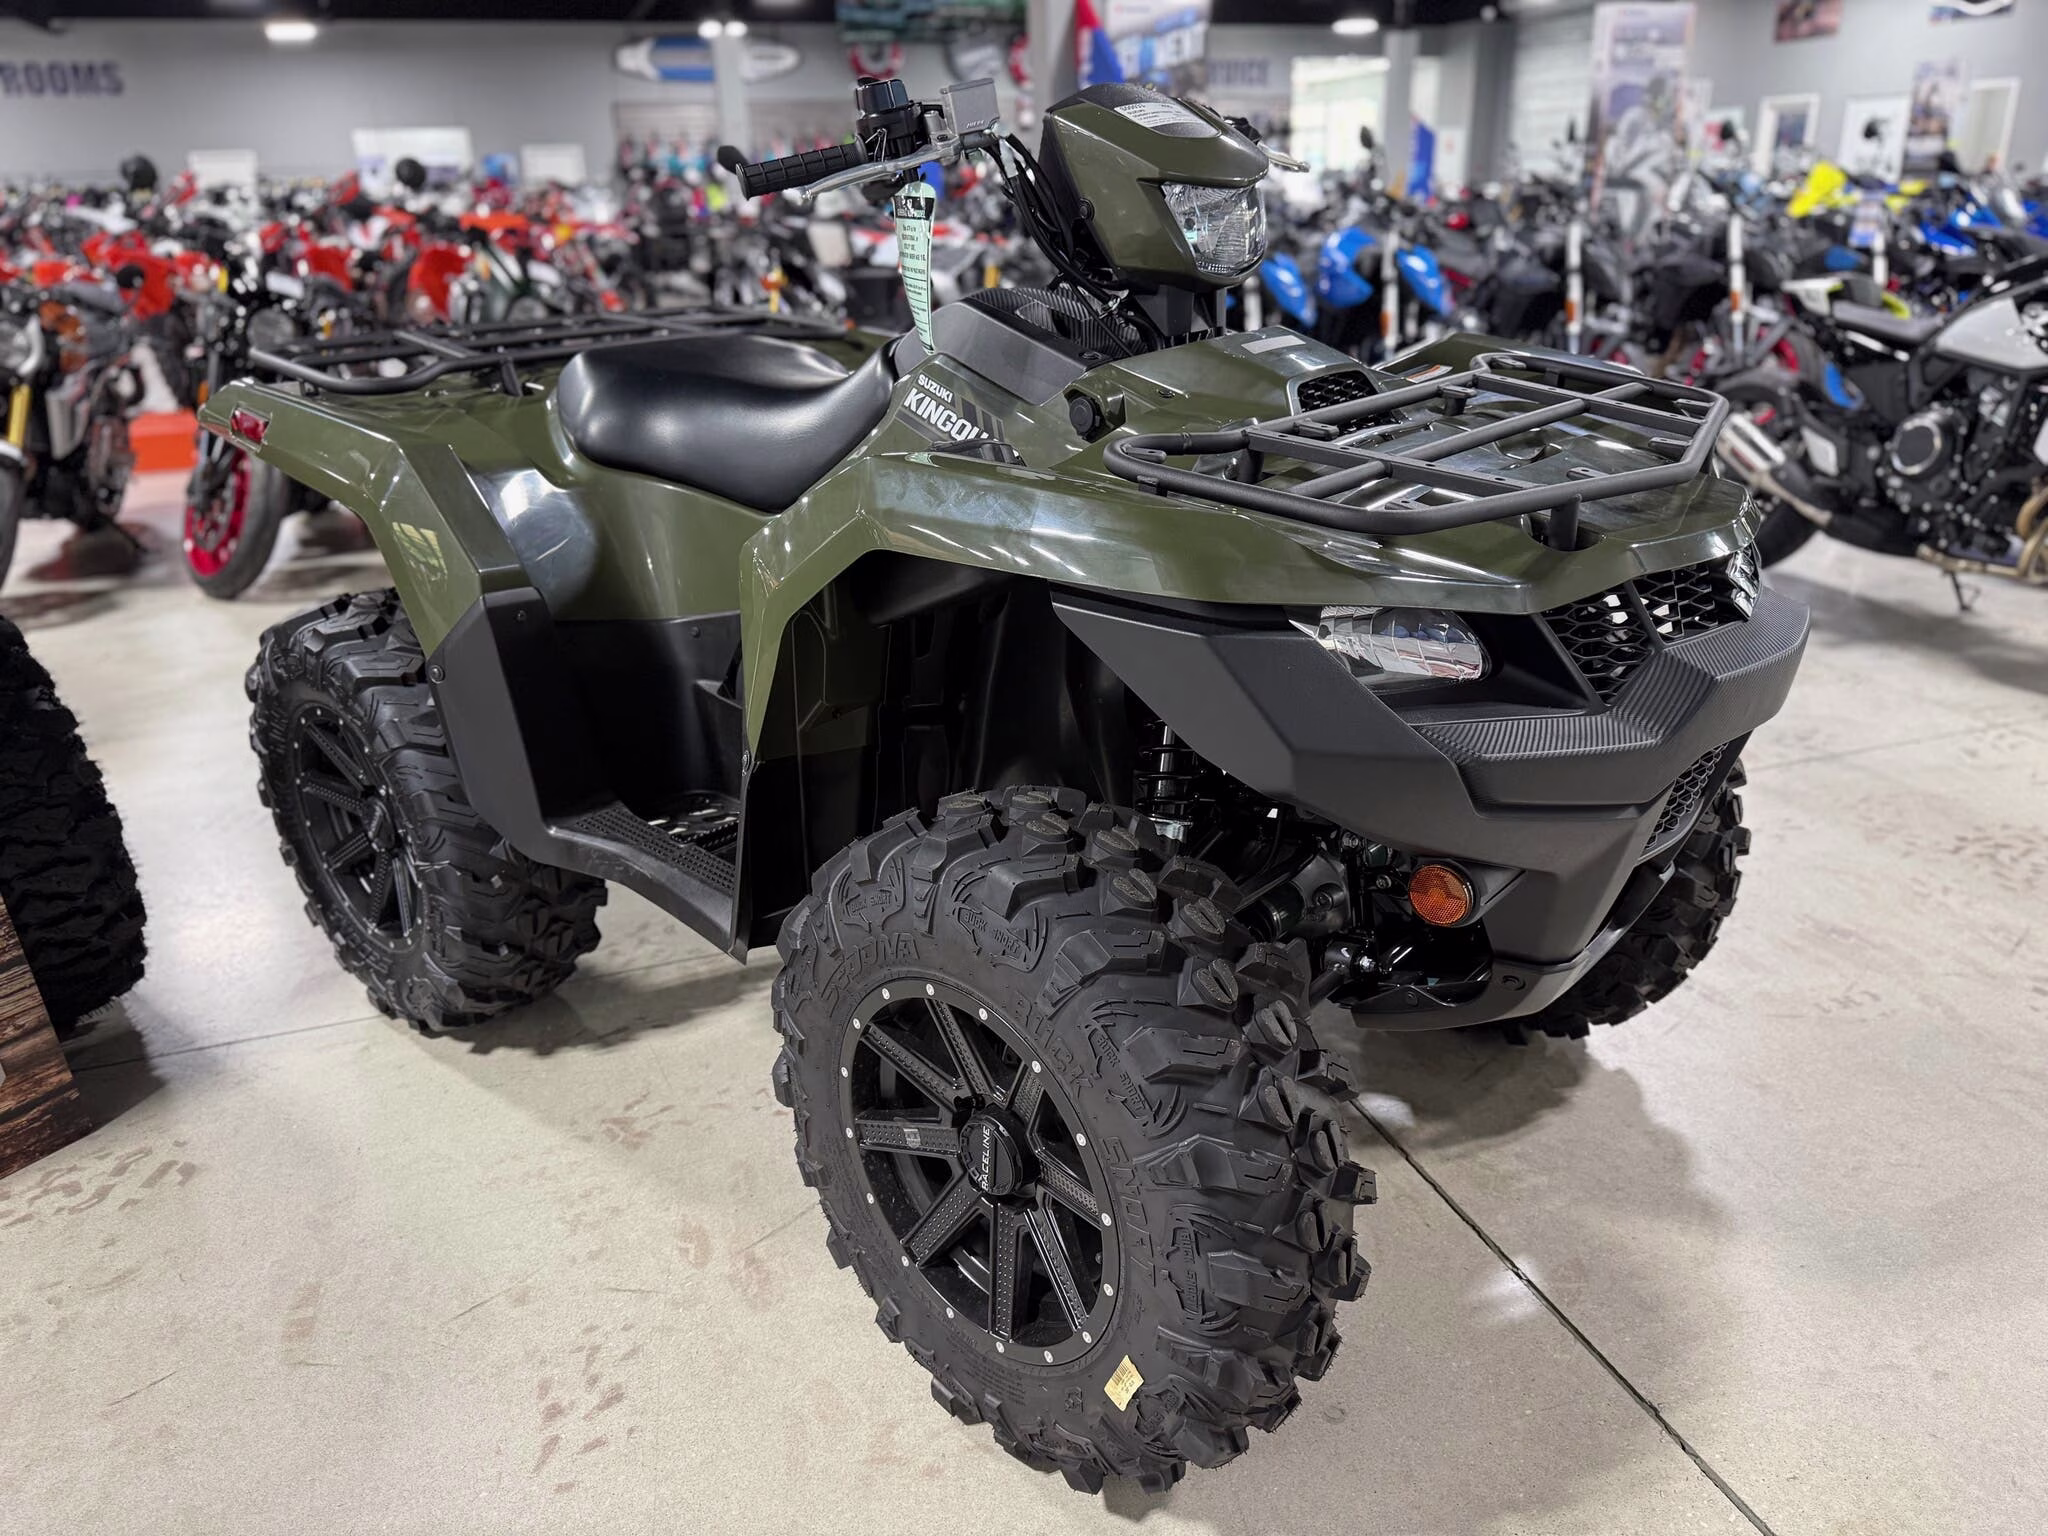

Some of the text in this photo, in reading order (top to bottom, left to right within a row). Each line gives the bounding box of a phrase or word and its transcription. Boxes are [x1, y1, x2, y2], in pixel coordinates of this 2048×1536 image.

[0, 61, 124, 97] ROOMS
[918, 374, 954, 403] SUZUKI
[964, 911, 988, 933] BUCK
[981, 1125, 991, 1192] RACELINE
